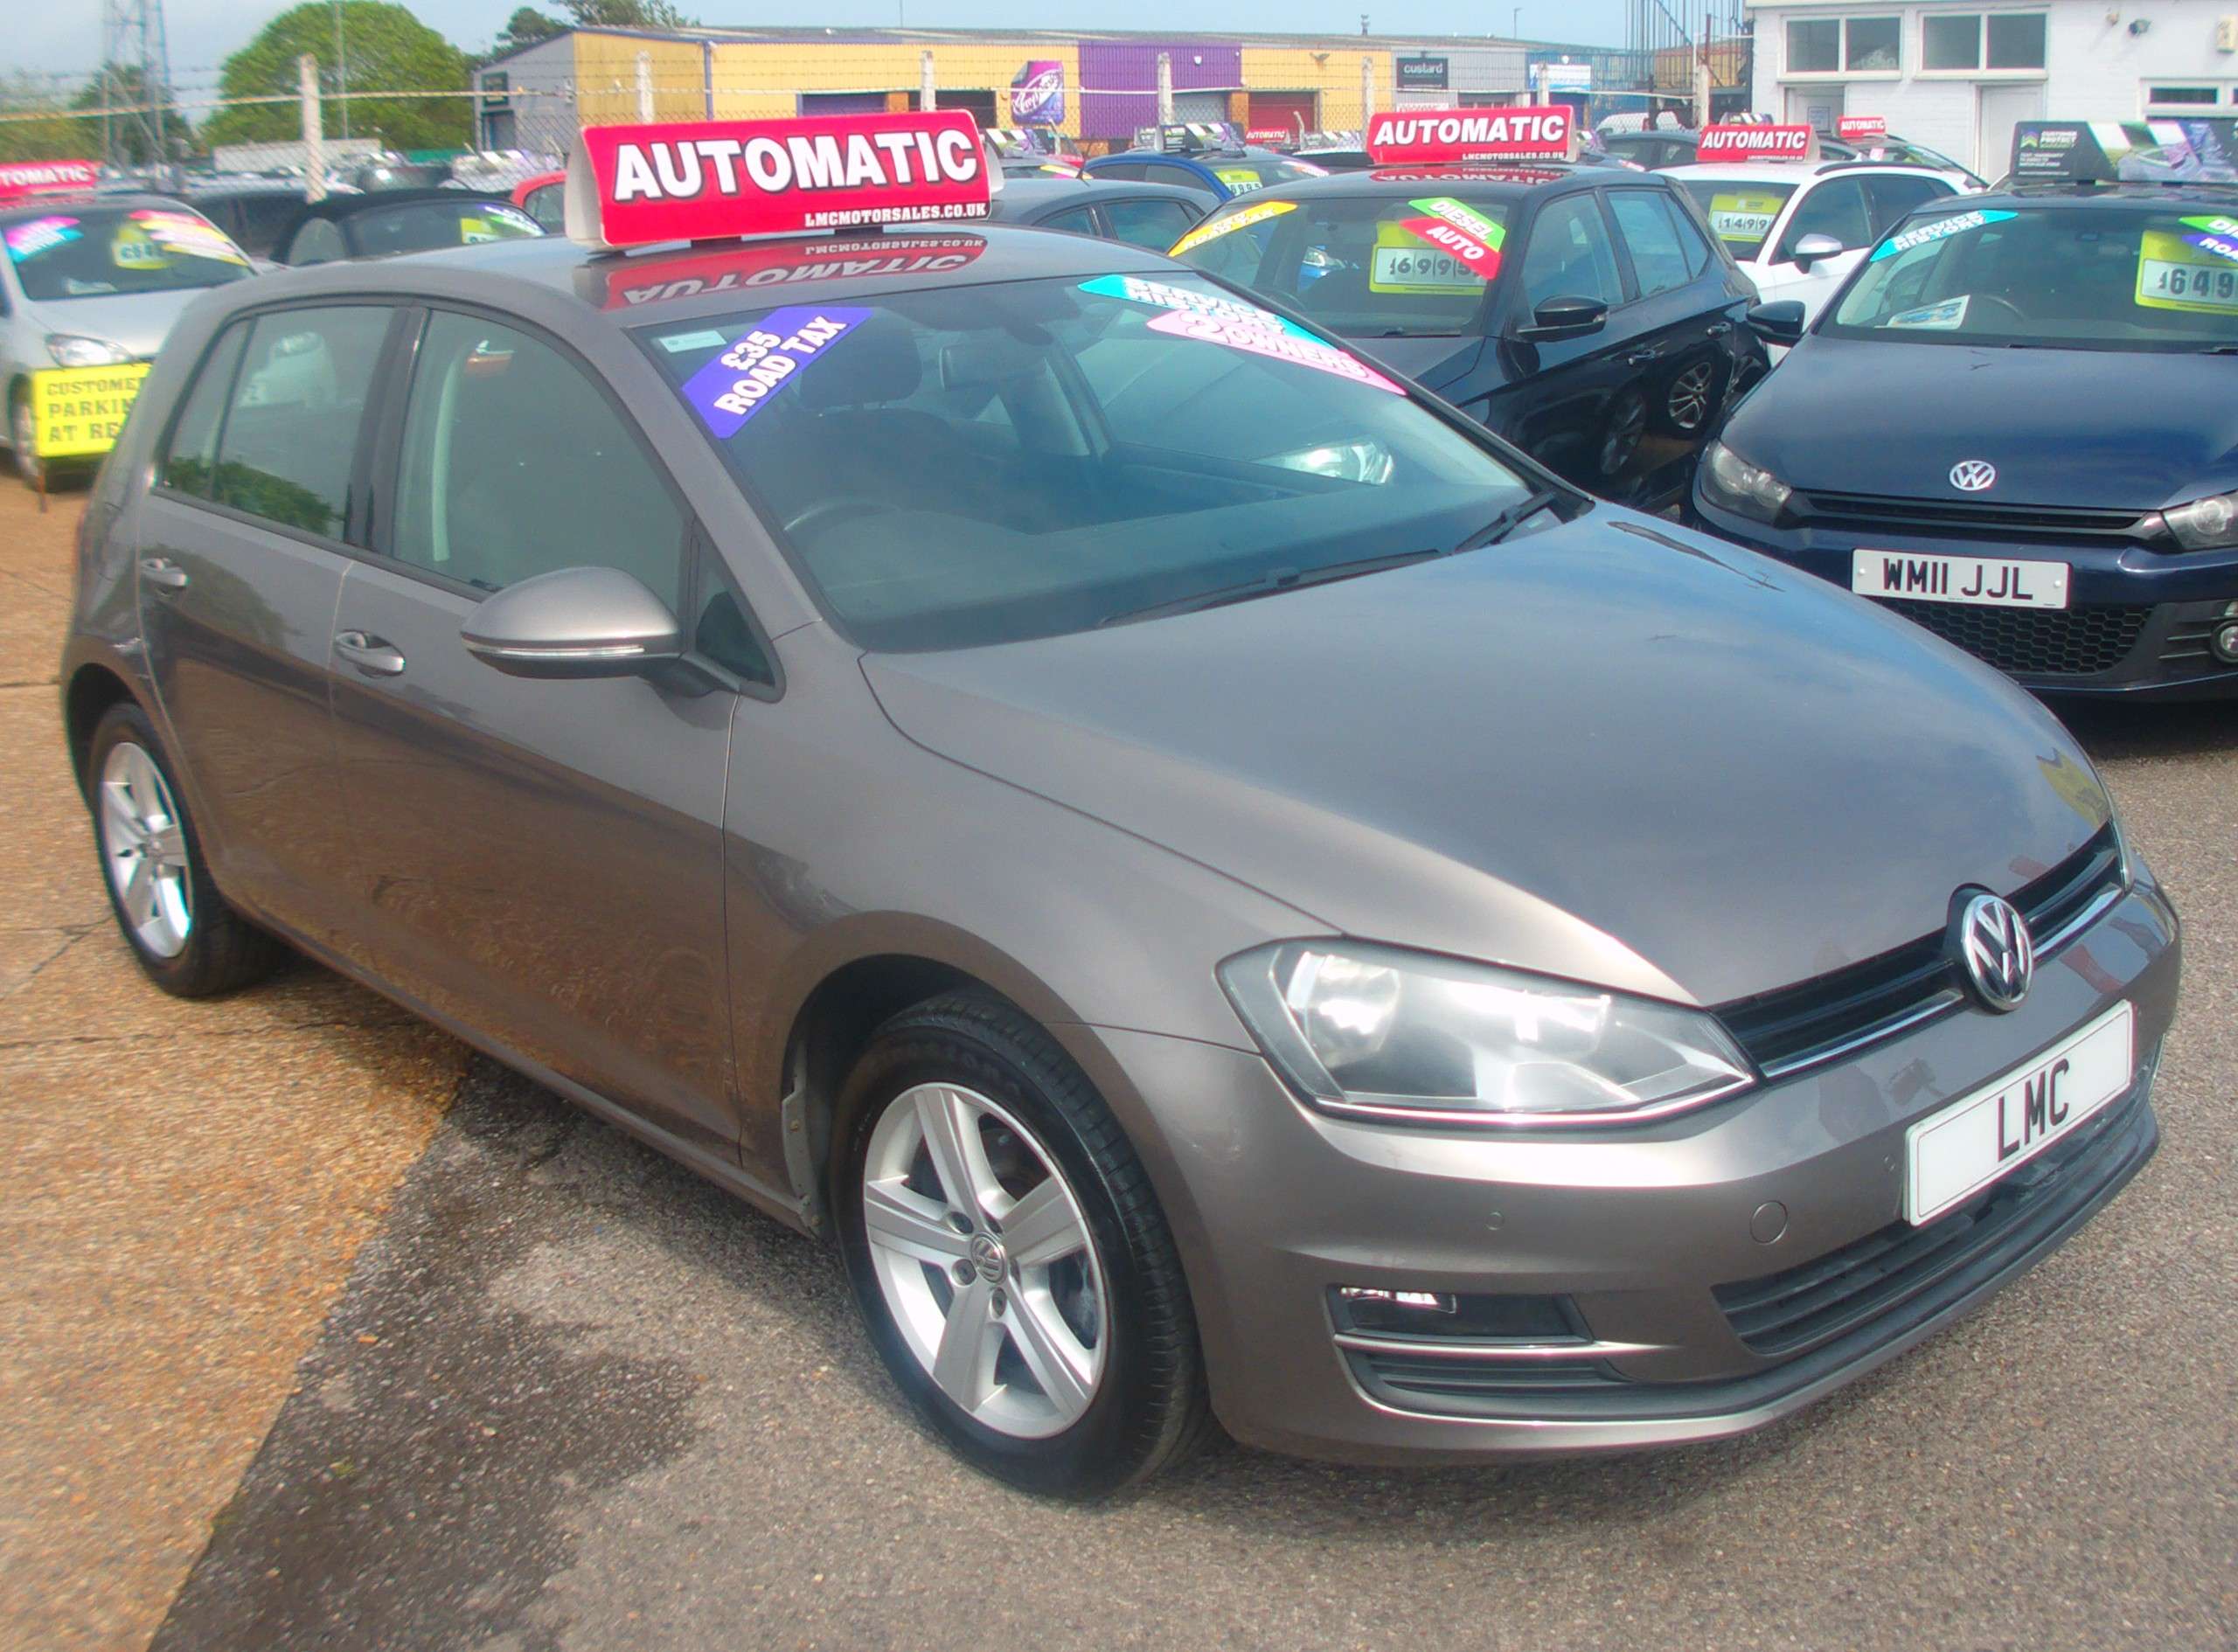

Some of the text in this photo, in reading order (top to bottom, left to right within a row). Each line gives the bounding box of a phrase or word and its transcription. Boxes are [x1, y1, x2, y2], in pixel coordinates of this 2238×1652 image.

[1403, 62, 1443, 74] custard
[1373, 115, 1565, 146] AUTOMATIC
[1701, 131, 1806, 149] AUTOMATIC
[1840, 119, 1886, 131] AUTOMATIC
[614, 128, 978, 202] AUTOMATIC
[804, 203, 986, 227] LMCMOTORSALES.CO.UK
[1428, 200, 1493, 240] DIESEL
[1425, 226, 1484, 260] AUTO
[720, 330, 782, 371] £35
[1180, 313, 1369, 378] 2 OWNERS
[713, 316, 849, 415] ROAD TAX
[48, 425, 77, 442] AT
[1883, 558, 2033, 600] WM11 JJL
[1998, 1058, 2069, 1163] LMC
